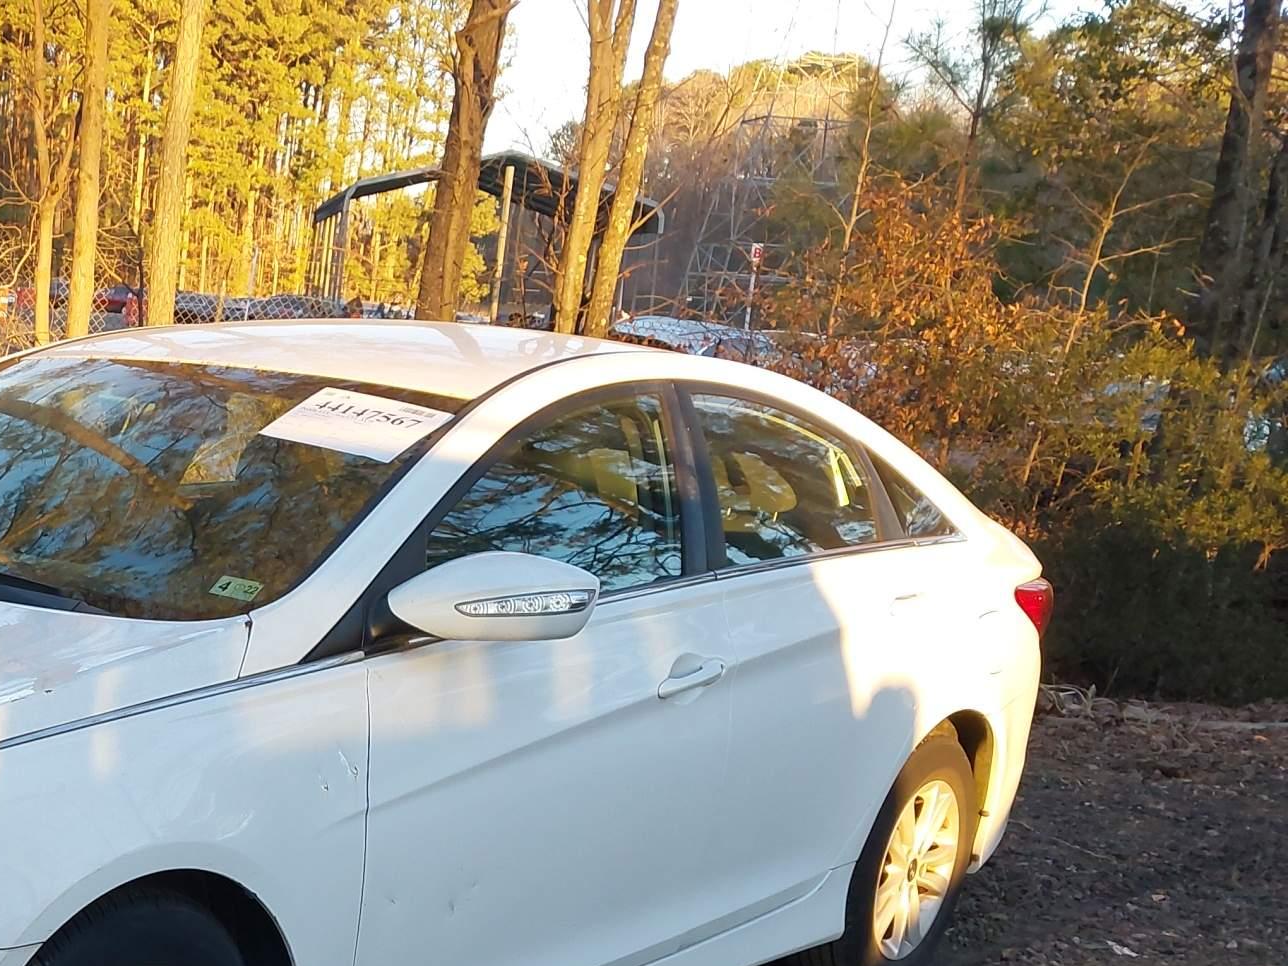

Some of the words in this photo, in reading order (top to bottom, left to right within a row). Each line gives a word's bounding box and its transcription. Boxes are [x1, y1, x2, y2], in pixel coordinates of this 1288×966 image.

[754, 247, 761, 258] B
[315, 400, 423, 428] 44147567
[218, 581, 232, 592] 4
